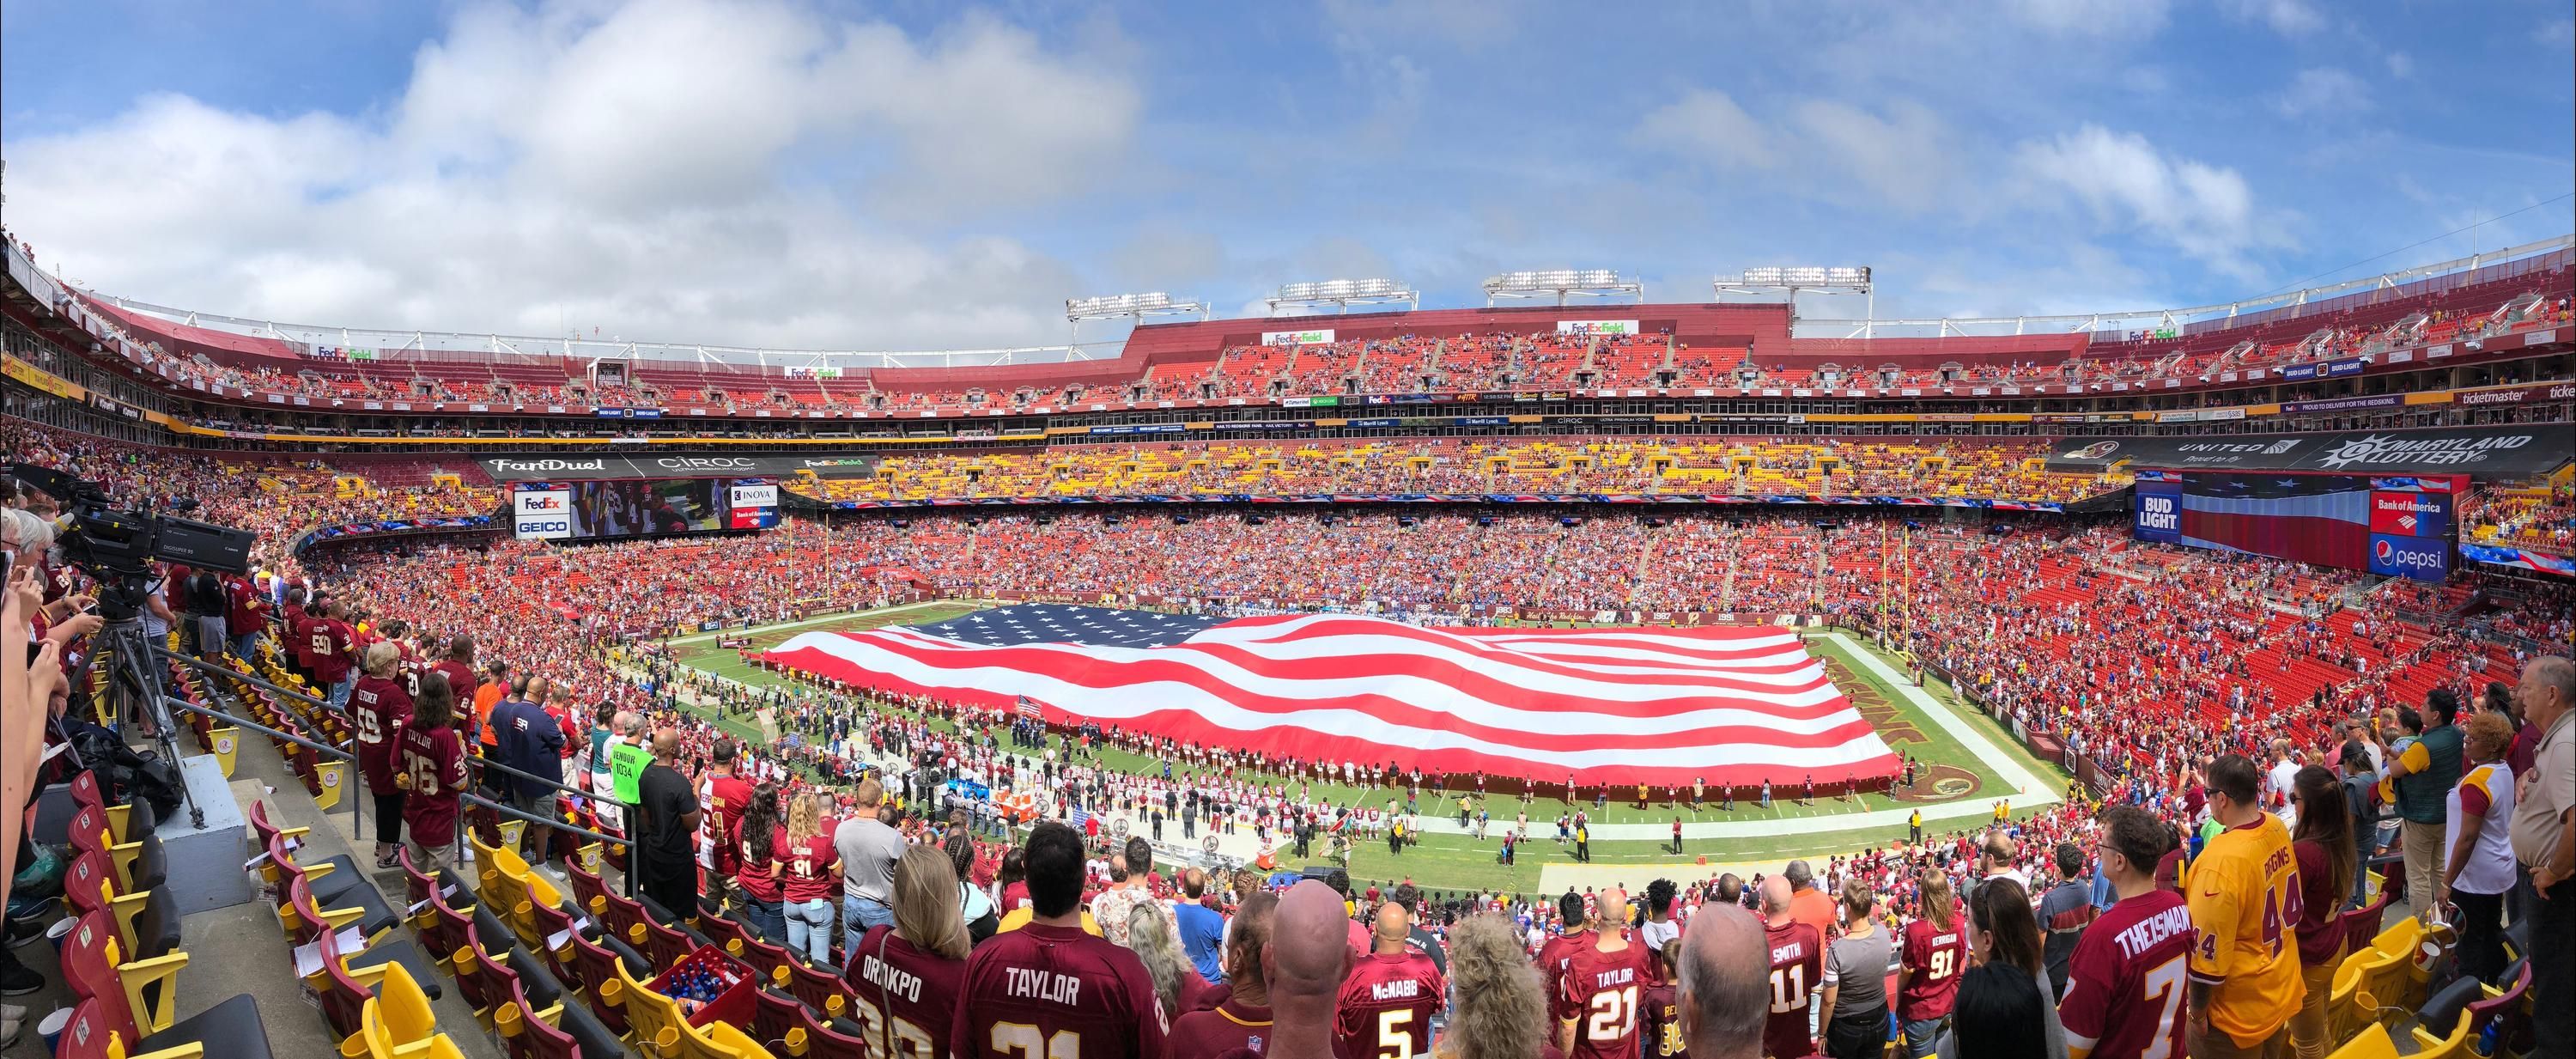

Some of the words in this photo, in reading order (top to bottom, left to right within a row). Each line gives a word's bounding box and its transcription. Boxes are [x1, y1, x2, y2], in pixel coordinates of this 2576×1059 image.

[1572, 323, 1624, 332] FedExField
[2129, 328, 2176, 342] FedExField
[1275, 332, 1321, 343] FedExField
[319, 346, 371, 359] FedExField
[792, 368, 836, 377] FedExField
[2178, 443, 2264, 452] UNITED
[2385, 435, 2532, 451] MARYLAND
[489, 459, 606, 472] FanDuel
[744, 490, 770, 499] INOVA
[526, 497, 560, 509] FedEx
[2145, 497, 2172, 514] BUD
[2379, 499, 2398, 509] Bank
[2398, 501, 2407, 510] of
[2407, 502, 2440, 513] America
[519, 521, 568, 533] GEICO
[163, 545, 186, 554] DIGISUPER
[2397, 550, 2441, 570] pepsi
[408, 728, 432, 750] TAYLOR
[613, 751, 635, 765] VENDOR
[617, 763, 633, 779] 1034
[793, 859, 814, 880] 91
[2262, 870, 2304, 962] 44
[1932, 934, 1957, 947] KERRIGAN
[2114, 905, 2190, 960] THEISMAN
[1772, 941, 1801, 964] SMITH
[1929, 948, 1954, 980] 91
[1597, 968, 1633, 989] TAYLOR
[1005, 967, 1080, 1007] TAYLOR
[1372, 979, 1418, 1001] McNABB
[1770, 964, 1807, 1013] 11
[1588, 985, 1638, 1040] 21
[2142, 952, 2186, 1059] 7
[1378, 1008, 1413, 1059] 5
